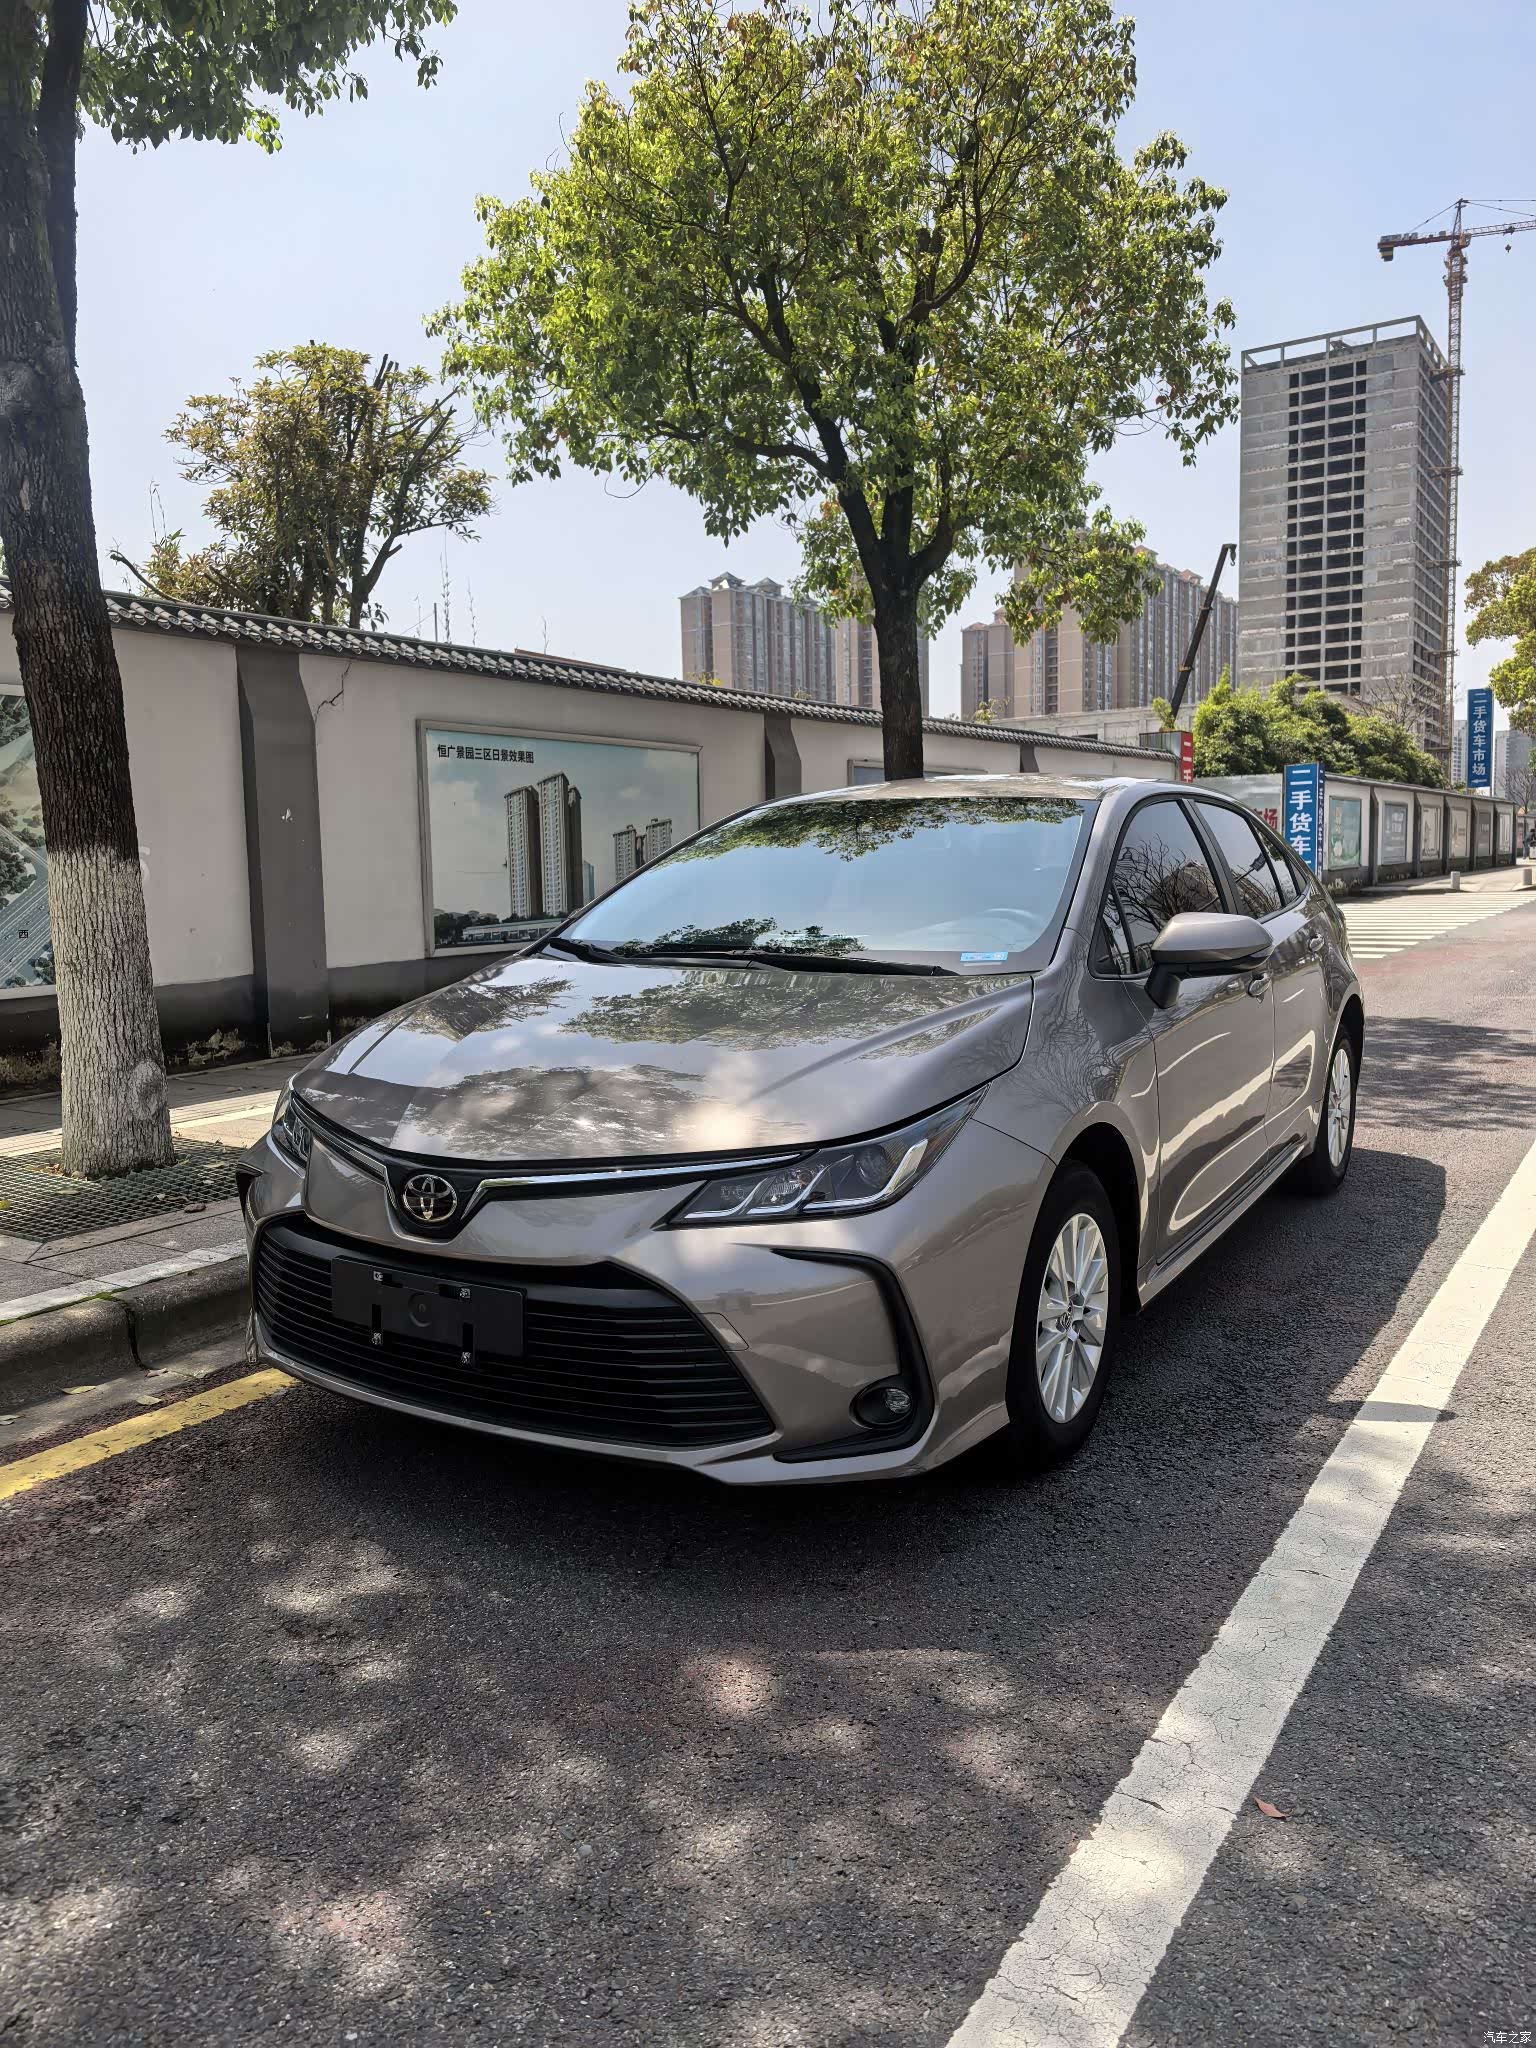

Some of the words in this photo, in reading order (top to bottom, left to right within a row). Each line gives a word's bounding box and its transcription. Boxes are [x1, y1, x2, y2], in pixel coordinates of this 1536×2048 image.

[437, 743, 535, 764] 恒广景园三区日景效果图
[1472, 692, 1488, 776] 二手货车市场
